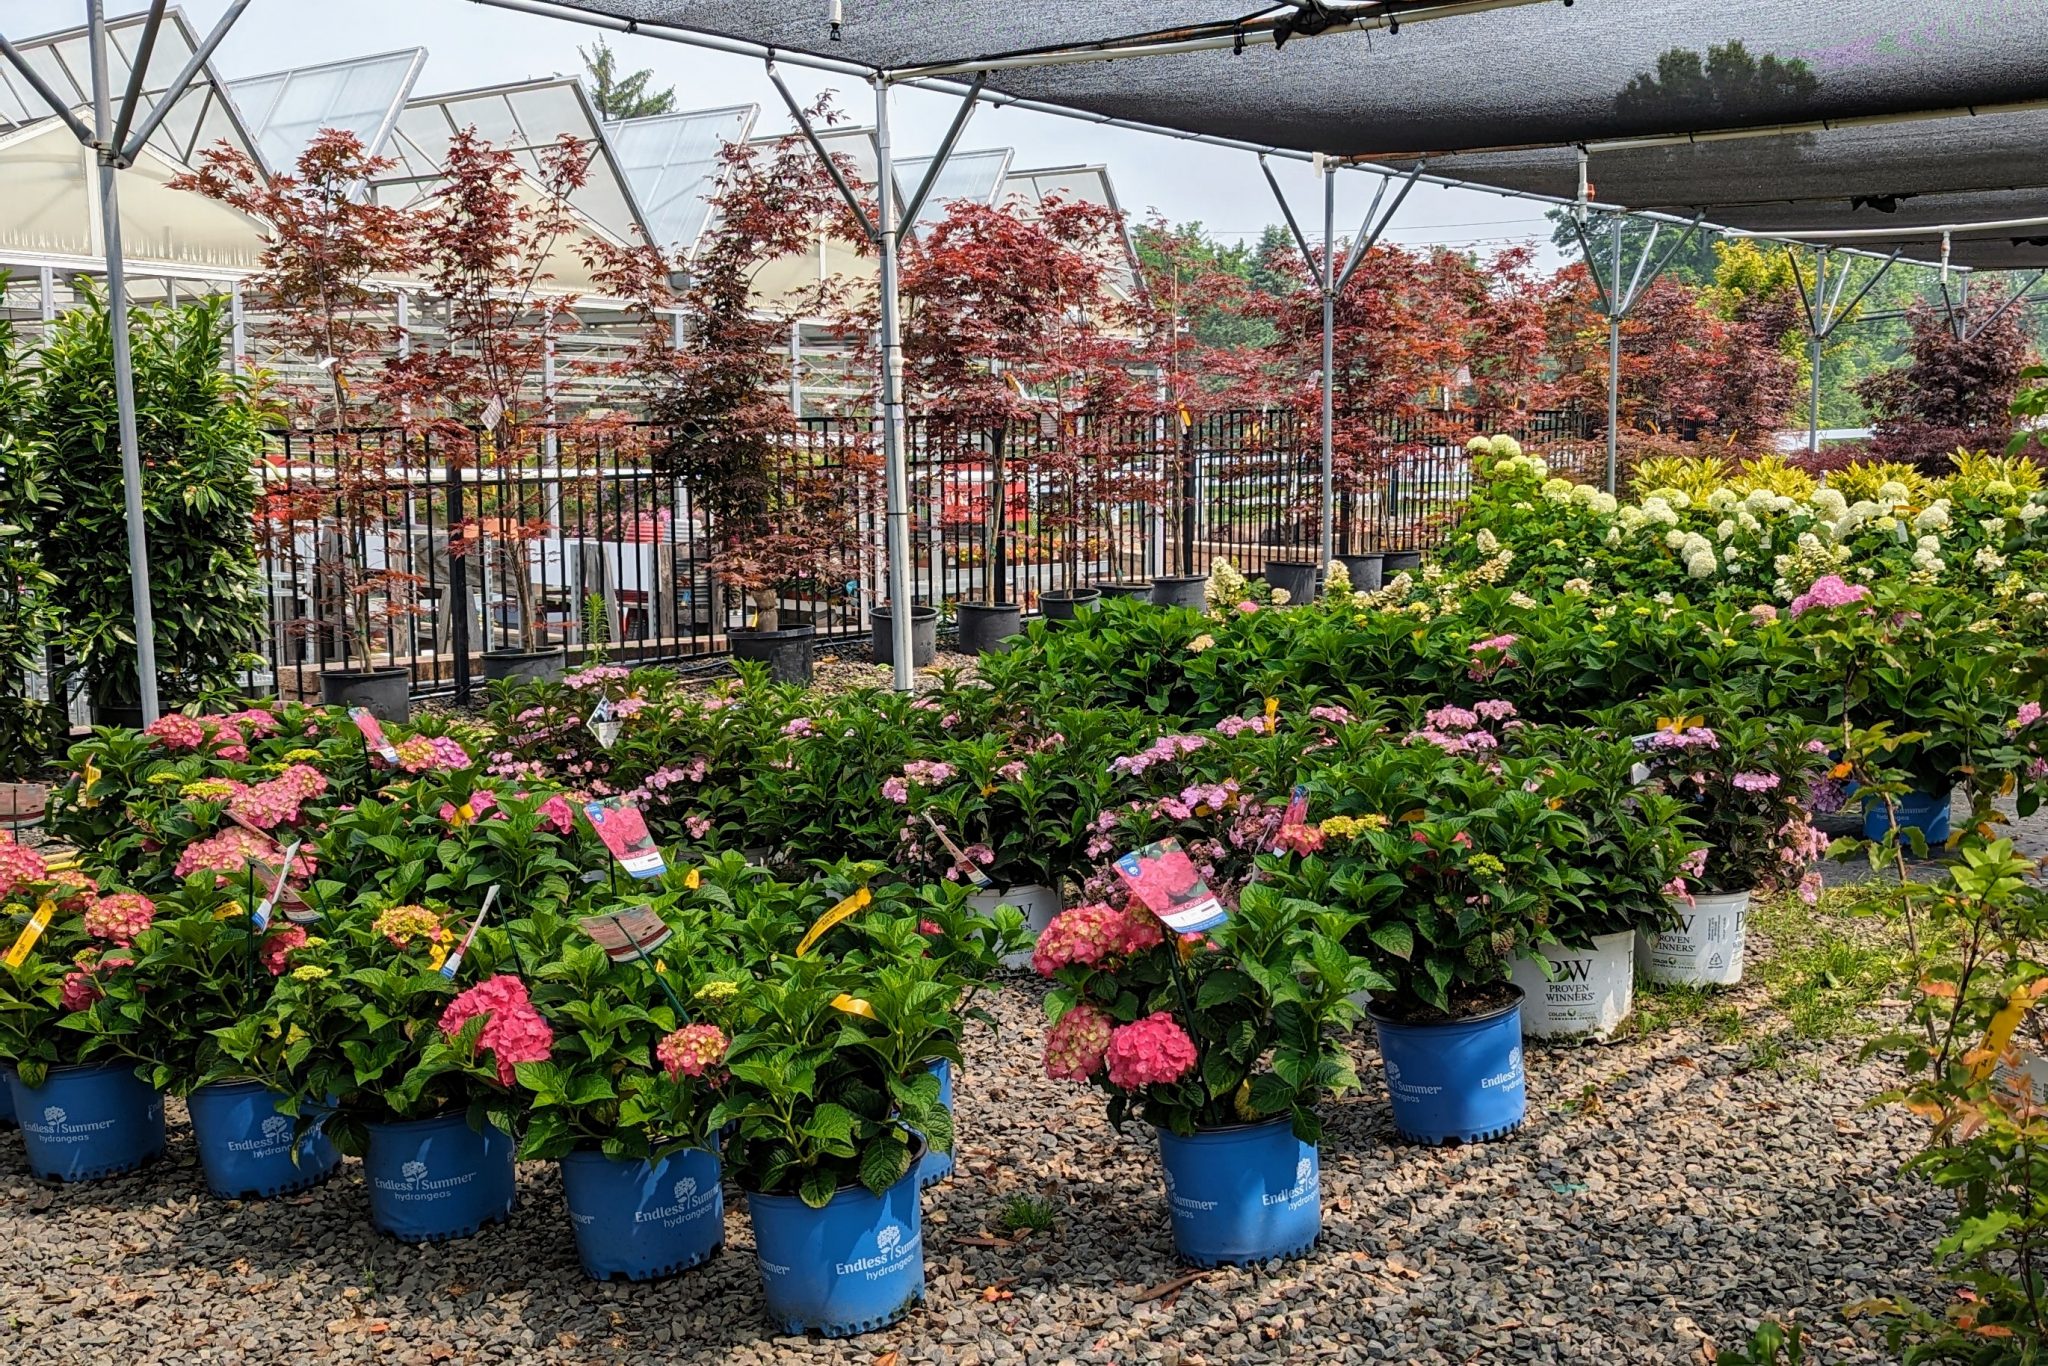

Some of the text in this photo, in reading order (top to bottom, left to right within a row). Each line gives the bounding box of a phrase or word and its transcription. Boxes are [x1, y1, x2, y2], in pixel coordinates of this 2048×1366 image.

[1659, 934, 1691, 944] ROVEN
[1659, 944, 1694, 953] INNERS
[1549, 984, 1589, 993] PROVEN
[1545, 992, 1593, 1002] WINNERS
[1480, 1069, 1516, 1089] Endless
[1398, 1081, 1439, 1095] Summer
[24, 1120, 111, 1134] Endless Summer
[39, 1134, 90, 1144] hydrangeas
[227, 1138, 274, 1152] Endless
[374, 1172, 475, 1191] Endless Summer
[394, 1189, 452, 1202] hydrangeas
[1172, 1192, 1216, 1211] Summer
[1262, 1184, 1304, 1206] Endless
[634, 1202, 685, 1223] Endless
[663, 1202, 713, 1229] hydrangeas
[835, 1252, 888, 1276] Endless
